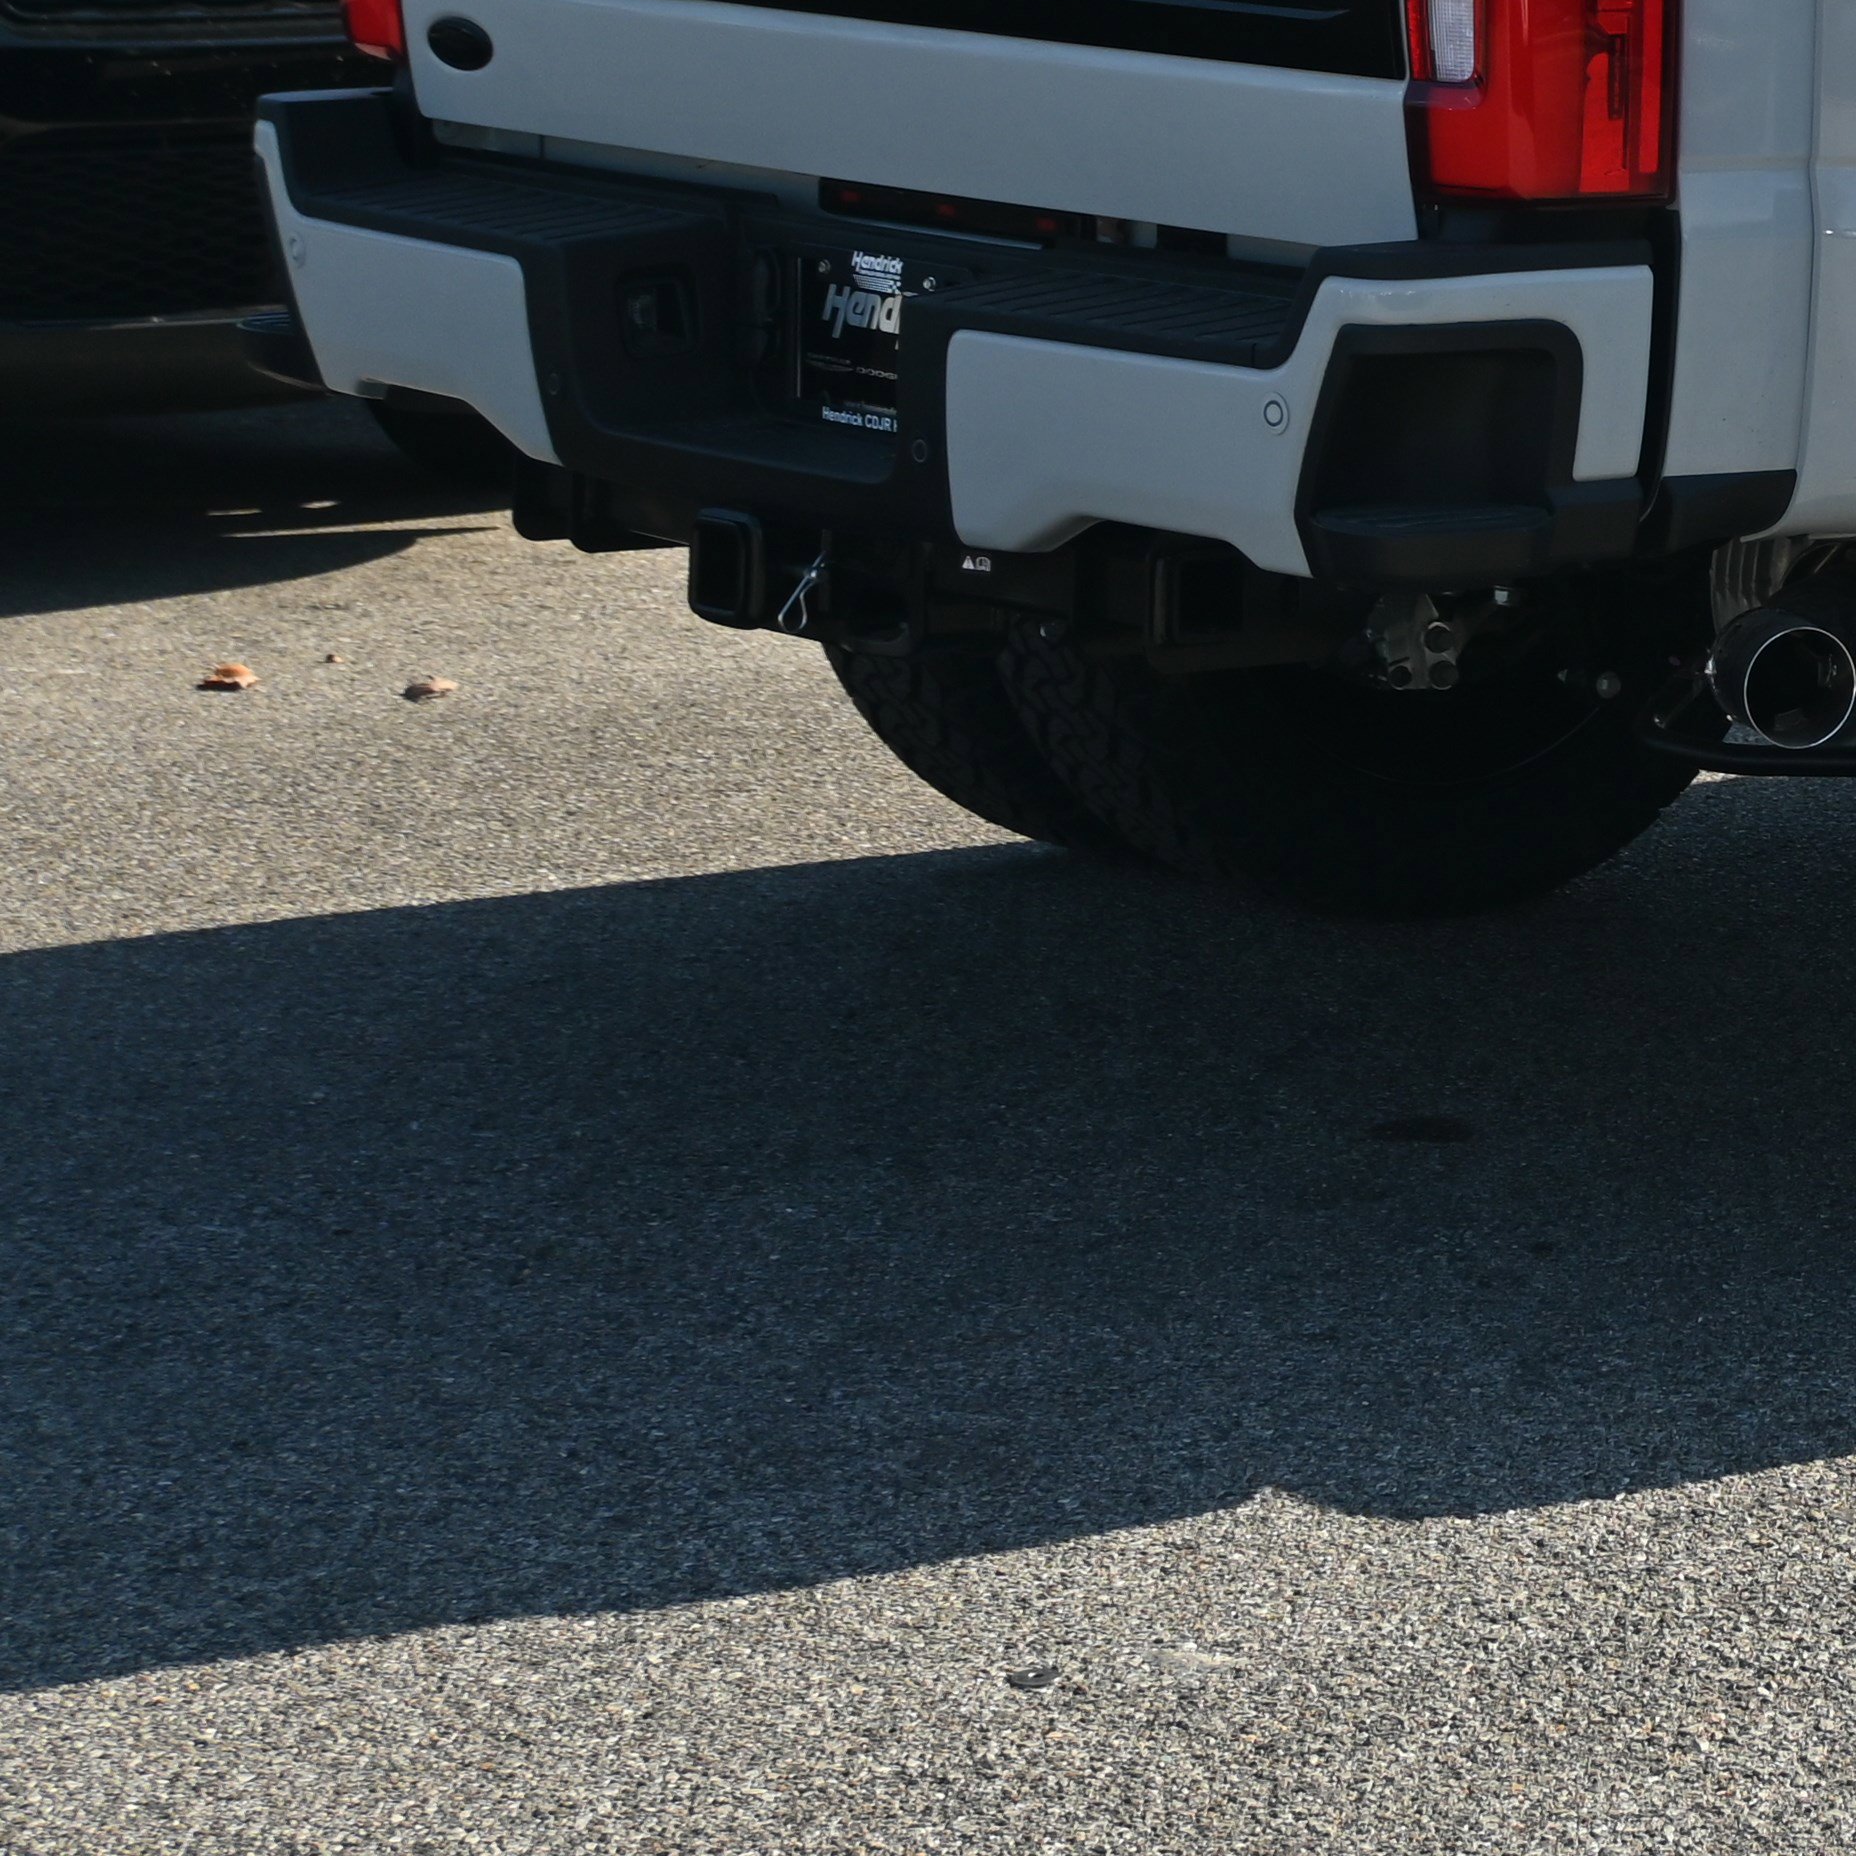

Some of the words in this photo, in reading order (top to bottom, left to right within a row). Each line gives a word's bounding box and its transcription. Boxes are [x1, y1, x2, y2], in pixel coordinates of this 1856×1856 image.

[852, 250, 904, 274] Hendrick
[822, 283, 902, 340] Hend
[822, 405, 863, 427] Hendrick
[865, 414, 892, 432] CDJR
